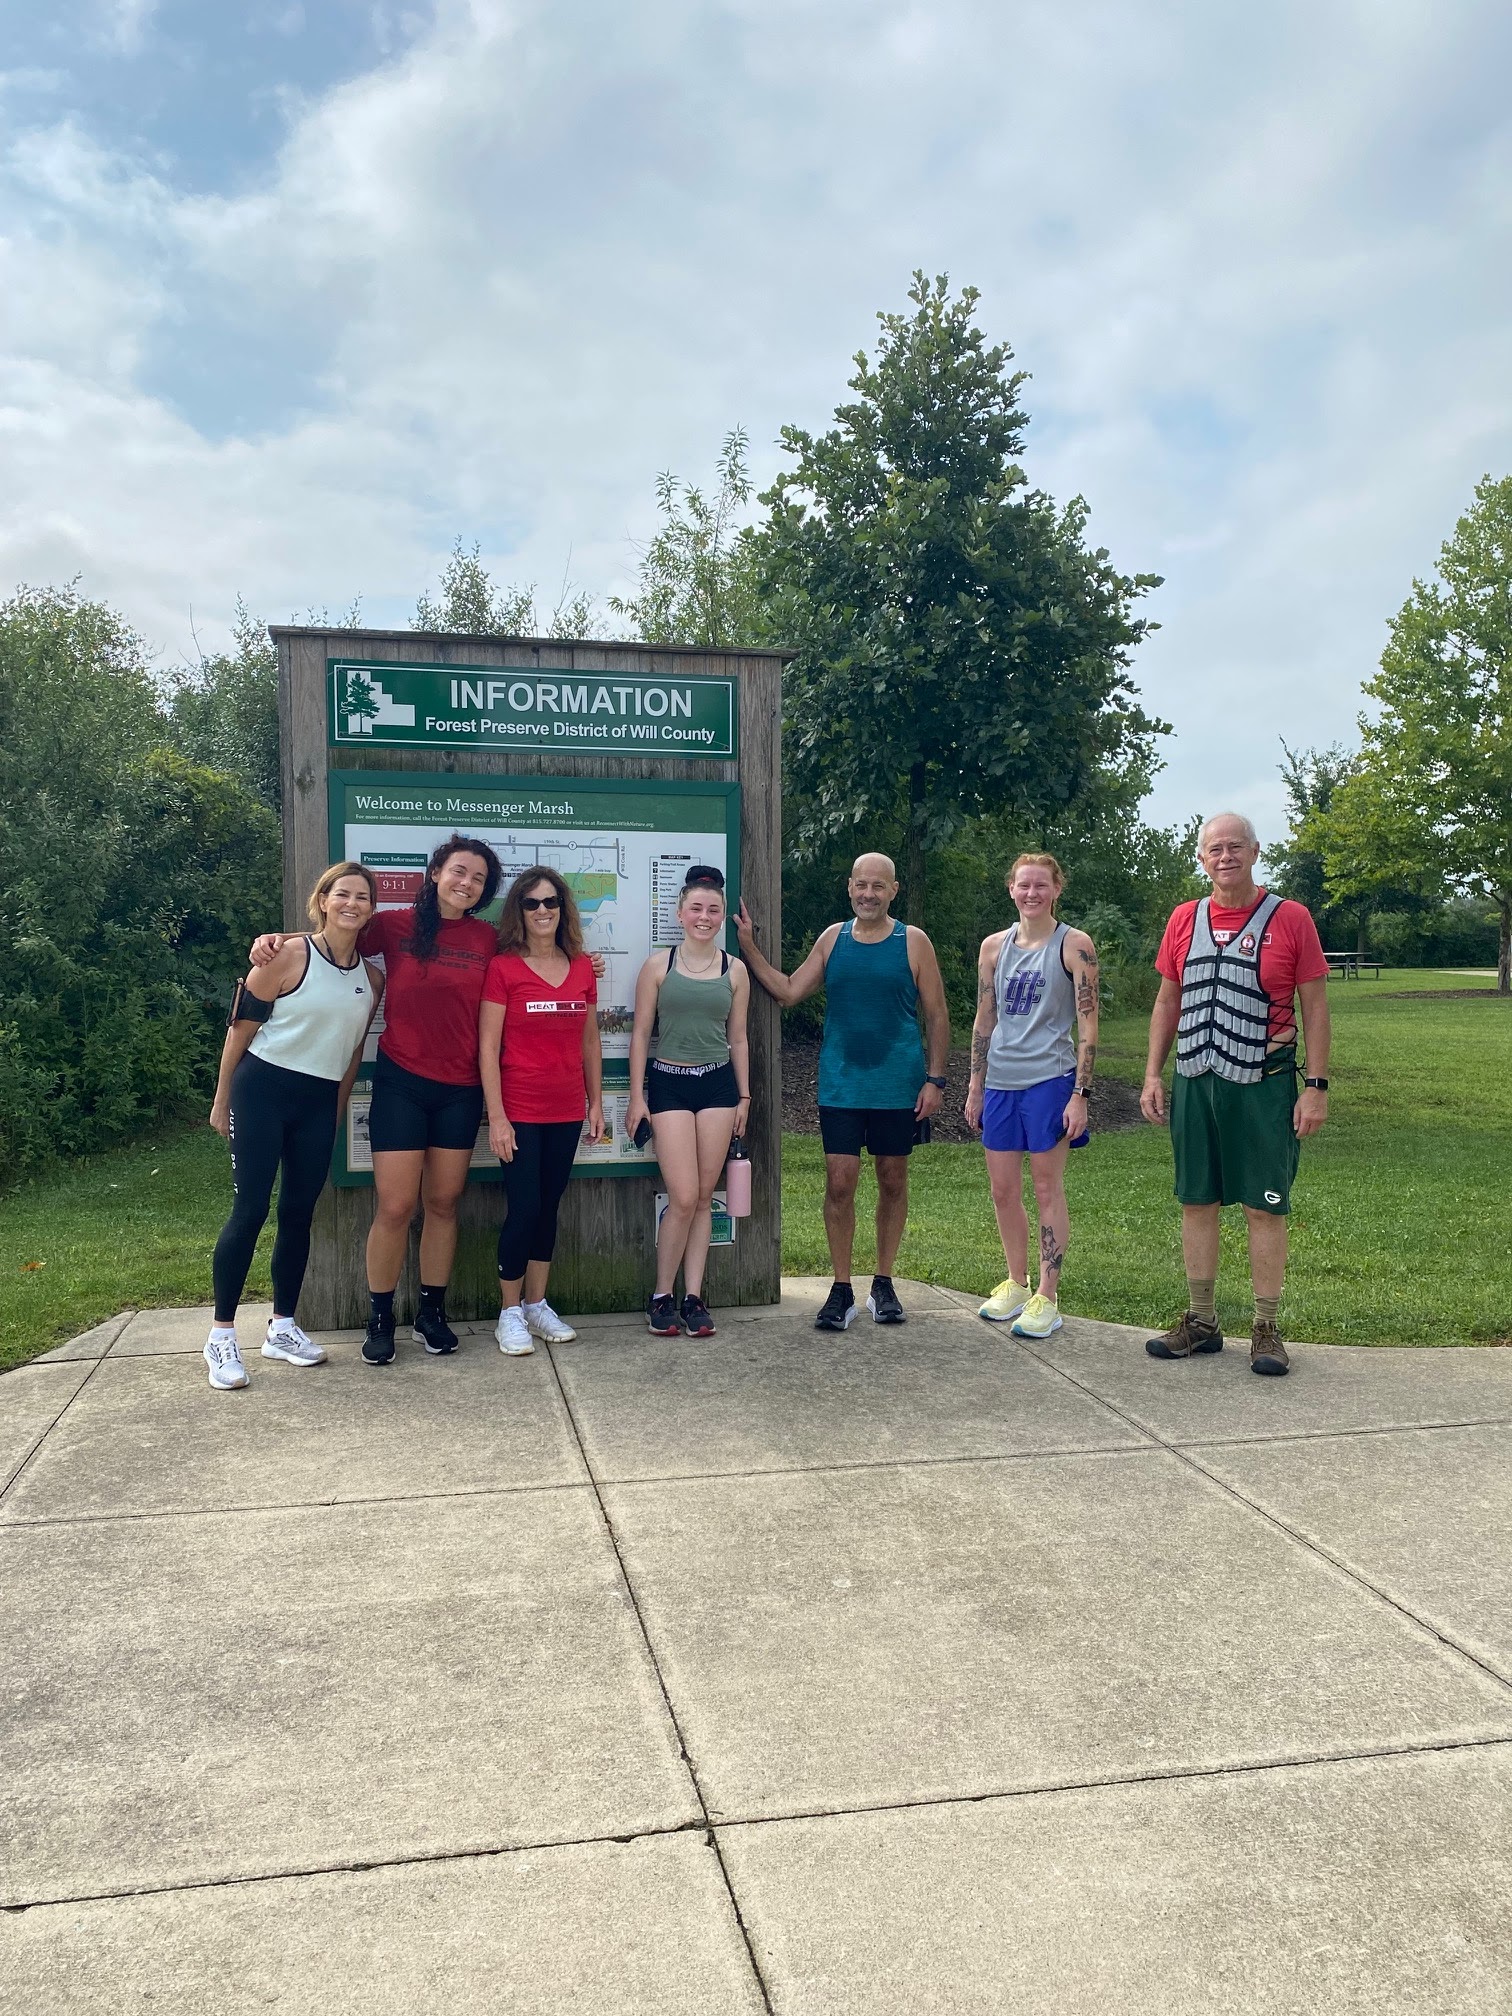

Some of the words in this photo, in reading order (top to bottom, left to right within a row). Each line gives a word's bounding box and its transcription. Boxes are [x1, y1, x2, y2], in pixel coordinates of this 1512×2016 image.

[450, 679, 692, 717] INFORMATION
[425, 717, 476, 732] Forest
[480, 719, 549, 736] Preserve
[553, 721, 608, 738] District
[612, 723, 628, 738] of
[629, 724, 658, 739] Will
[661, 725, 715, 744] County
[355, 796, 423, 810] Welcome
[427, 799, 442, 811] to
[446, 799, 525, 816] Messenger
[528, 801, 574, 815] Marsh
[658, 1062, 681, 1075] UNDER
[230, 1153, 237, 1170] DO
